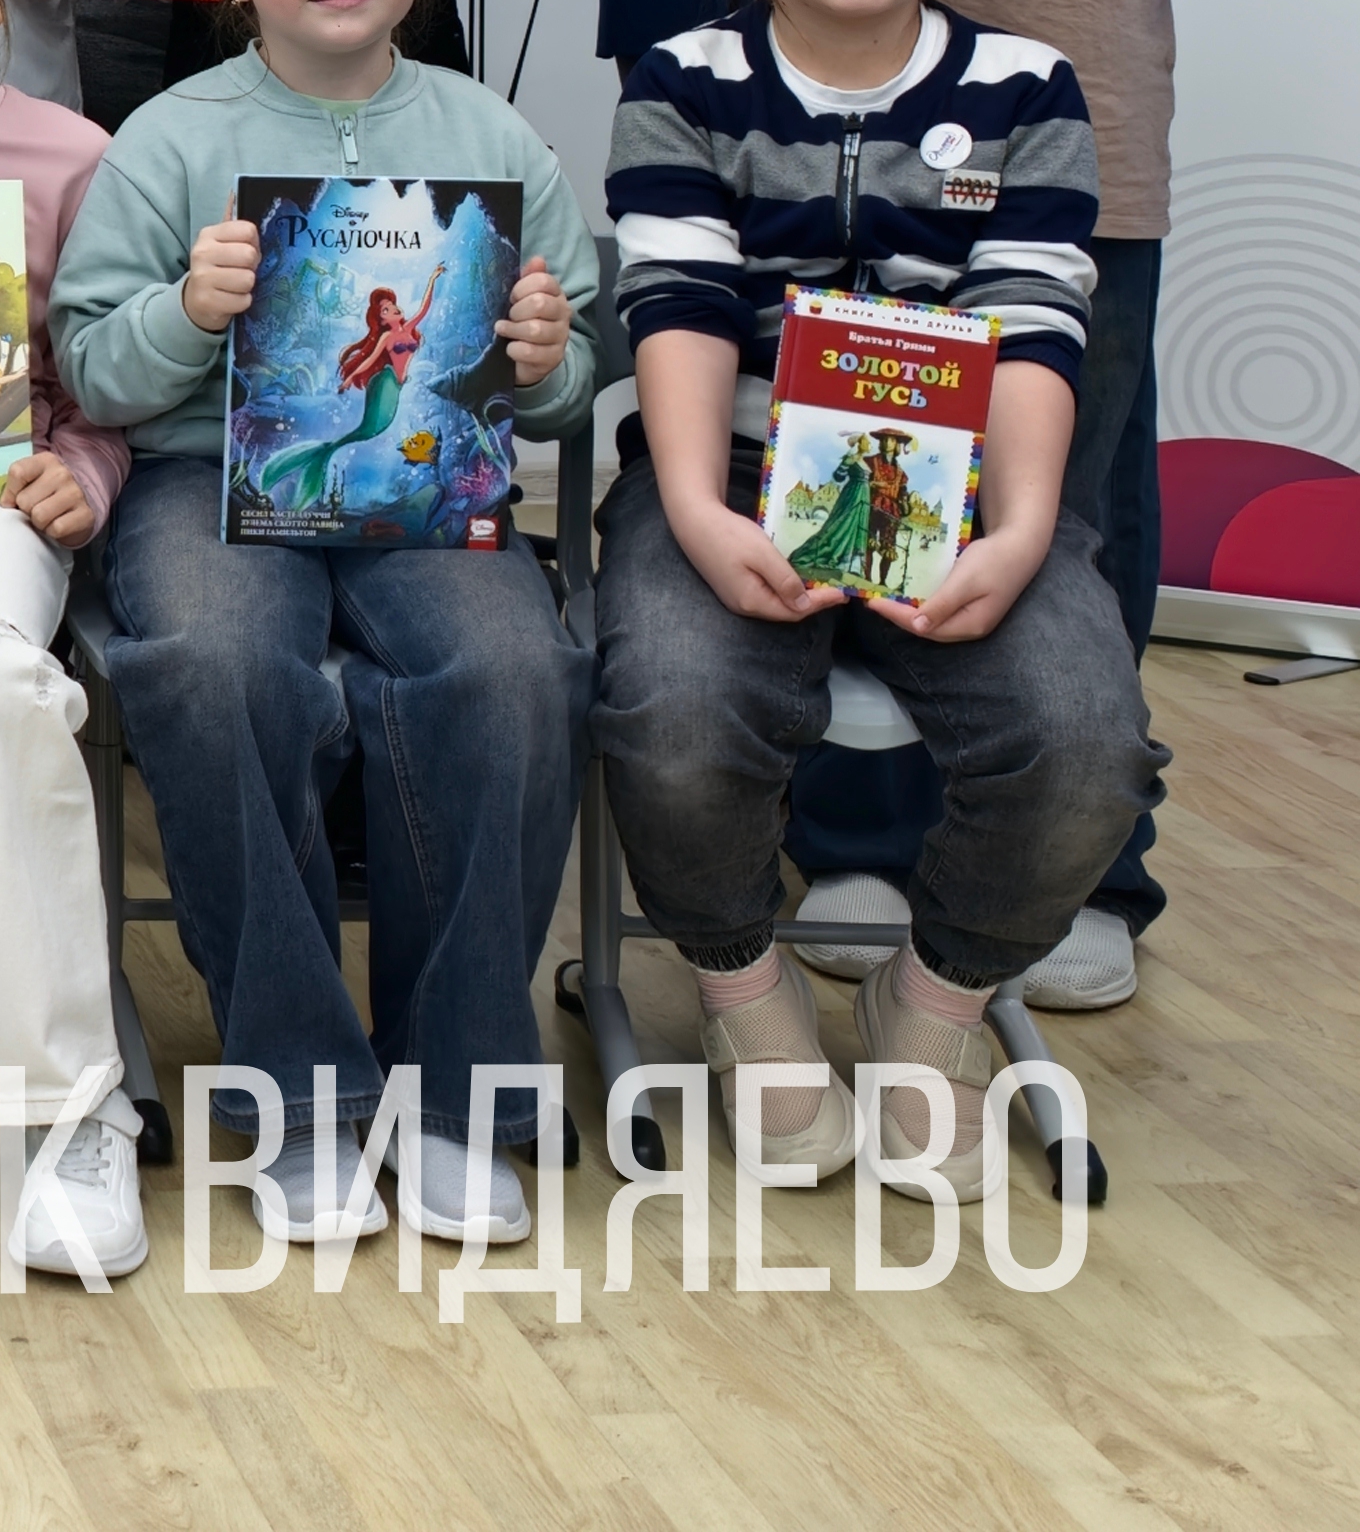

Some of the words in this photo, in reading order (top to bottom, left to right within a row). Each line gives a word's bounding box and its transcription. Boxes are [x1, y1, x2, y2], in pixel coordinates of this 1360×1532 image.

[330, 204, 370, 223] Disney
[835, 307, 874, 318] КНИГИ
[893, 316, 919, 325] МОИ
[926, 321, 973, 334] ДРУЗЬЯ
[848, 331, 893, 347] Братья
[895, 338, 936, 354] Гримм
[820, 349, 961, 389] ЗОЛОТОЙ
[853, 379, 928, 409] ГУСЬ
